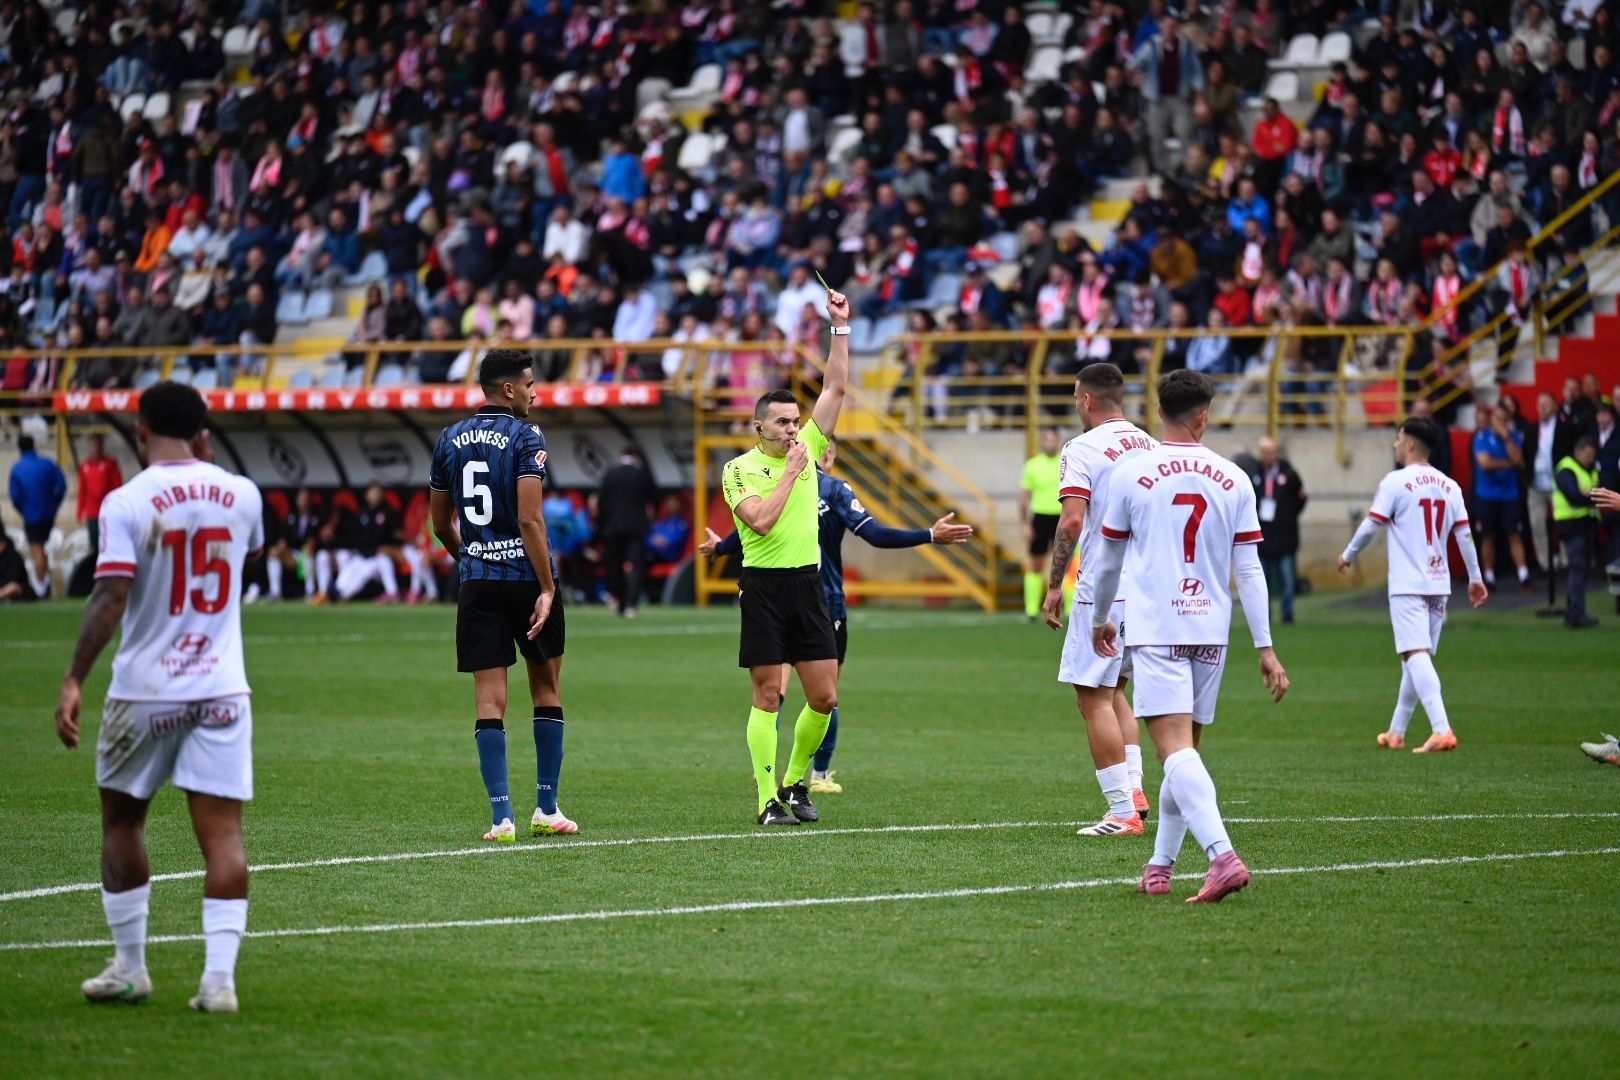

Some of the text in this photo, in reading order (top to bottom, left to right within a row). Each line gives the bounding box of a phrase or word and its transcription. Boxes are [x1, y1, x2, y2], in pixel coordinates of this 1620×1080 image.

[452, 430, 509, 449] YOUNESS
[151, 484, 235, 513] RIBEIRO
[462, 460, 493, 526] 5
[1172, 493, 1208, 563] 7
[482, 548, 525, 561] MOTOR
[162, 527, 232, 616] 15
[1171, 599, 1212, 607] HYUNDAI
